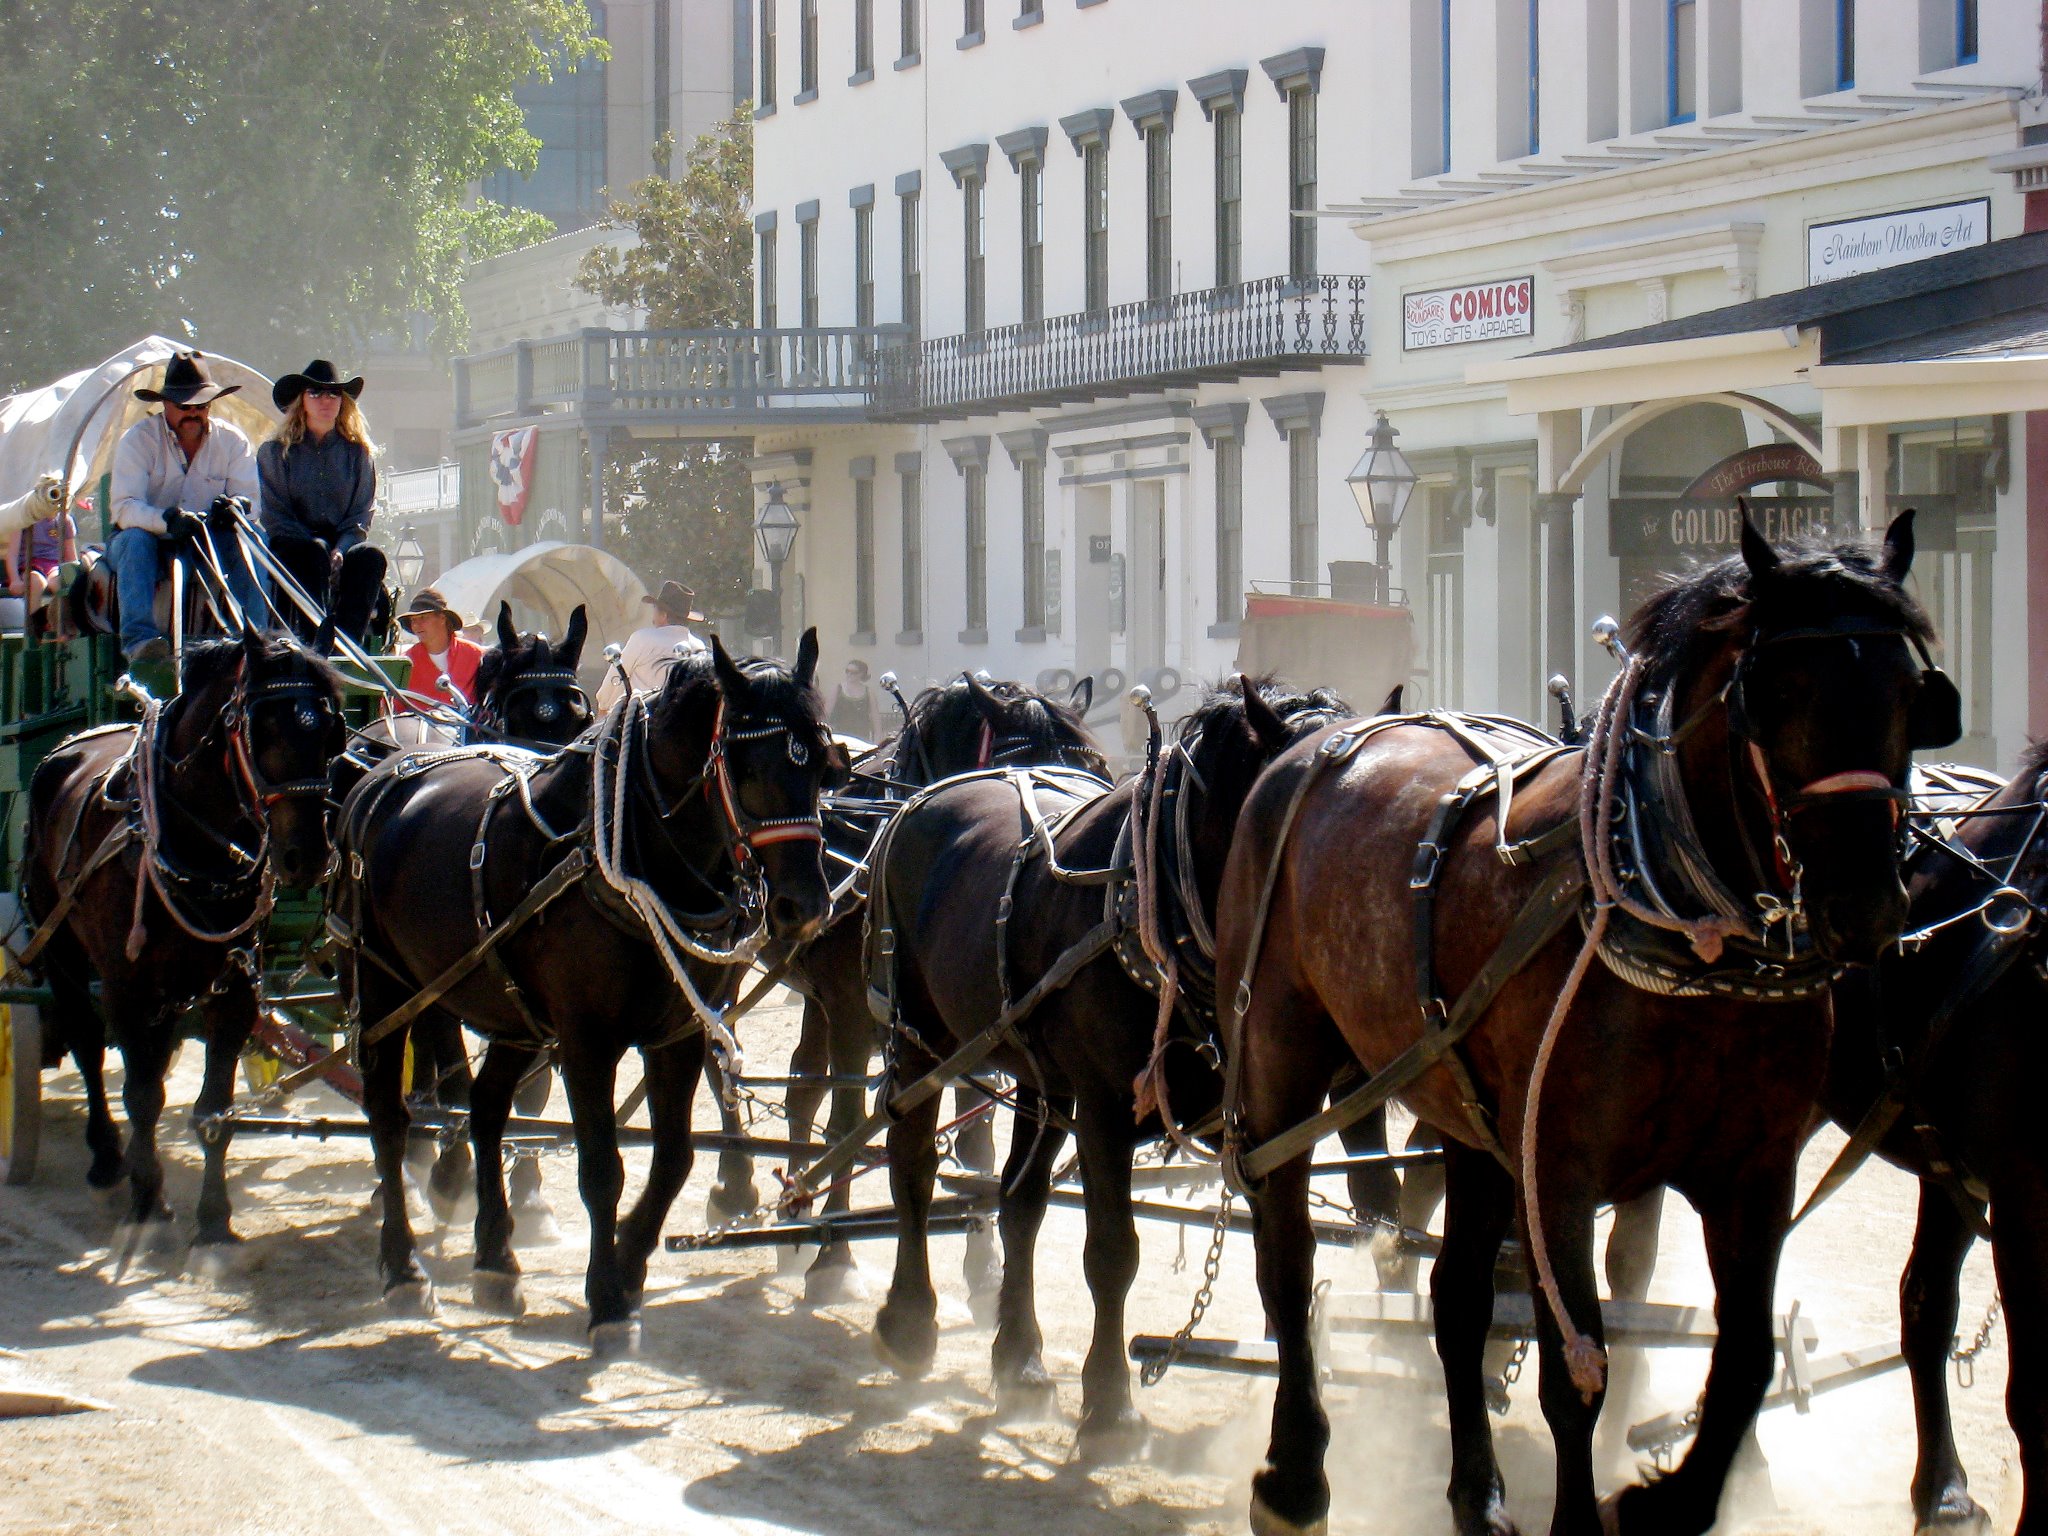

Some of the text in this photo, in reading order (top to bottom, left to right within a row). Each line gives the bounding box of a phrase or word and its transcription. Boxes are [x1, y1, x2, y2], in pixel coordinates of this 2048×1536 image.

[1823, 231, 1882, 265] Rainbow
[1886, 222, 1937, 253] Wooden
[1406, 304, 1445, 324] BOUNDARIES
[1450, 282, 1529, 323] COMICS
[1411, 318, 1526, 346] TOYS GIFTS APPAREL
[1711, 472, 1735, 492] The
[1733, 453, 1791, 483] Firehouse
[1670, 508, 1755, 546] GOLDE
